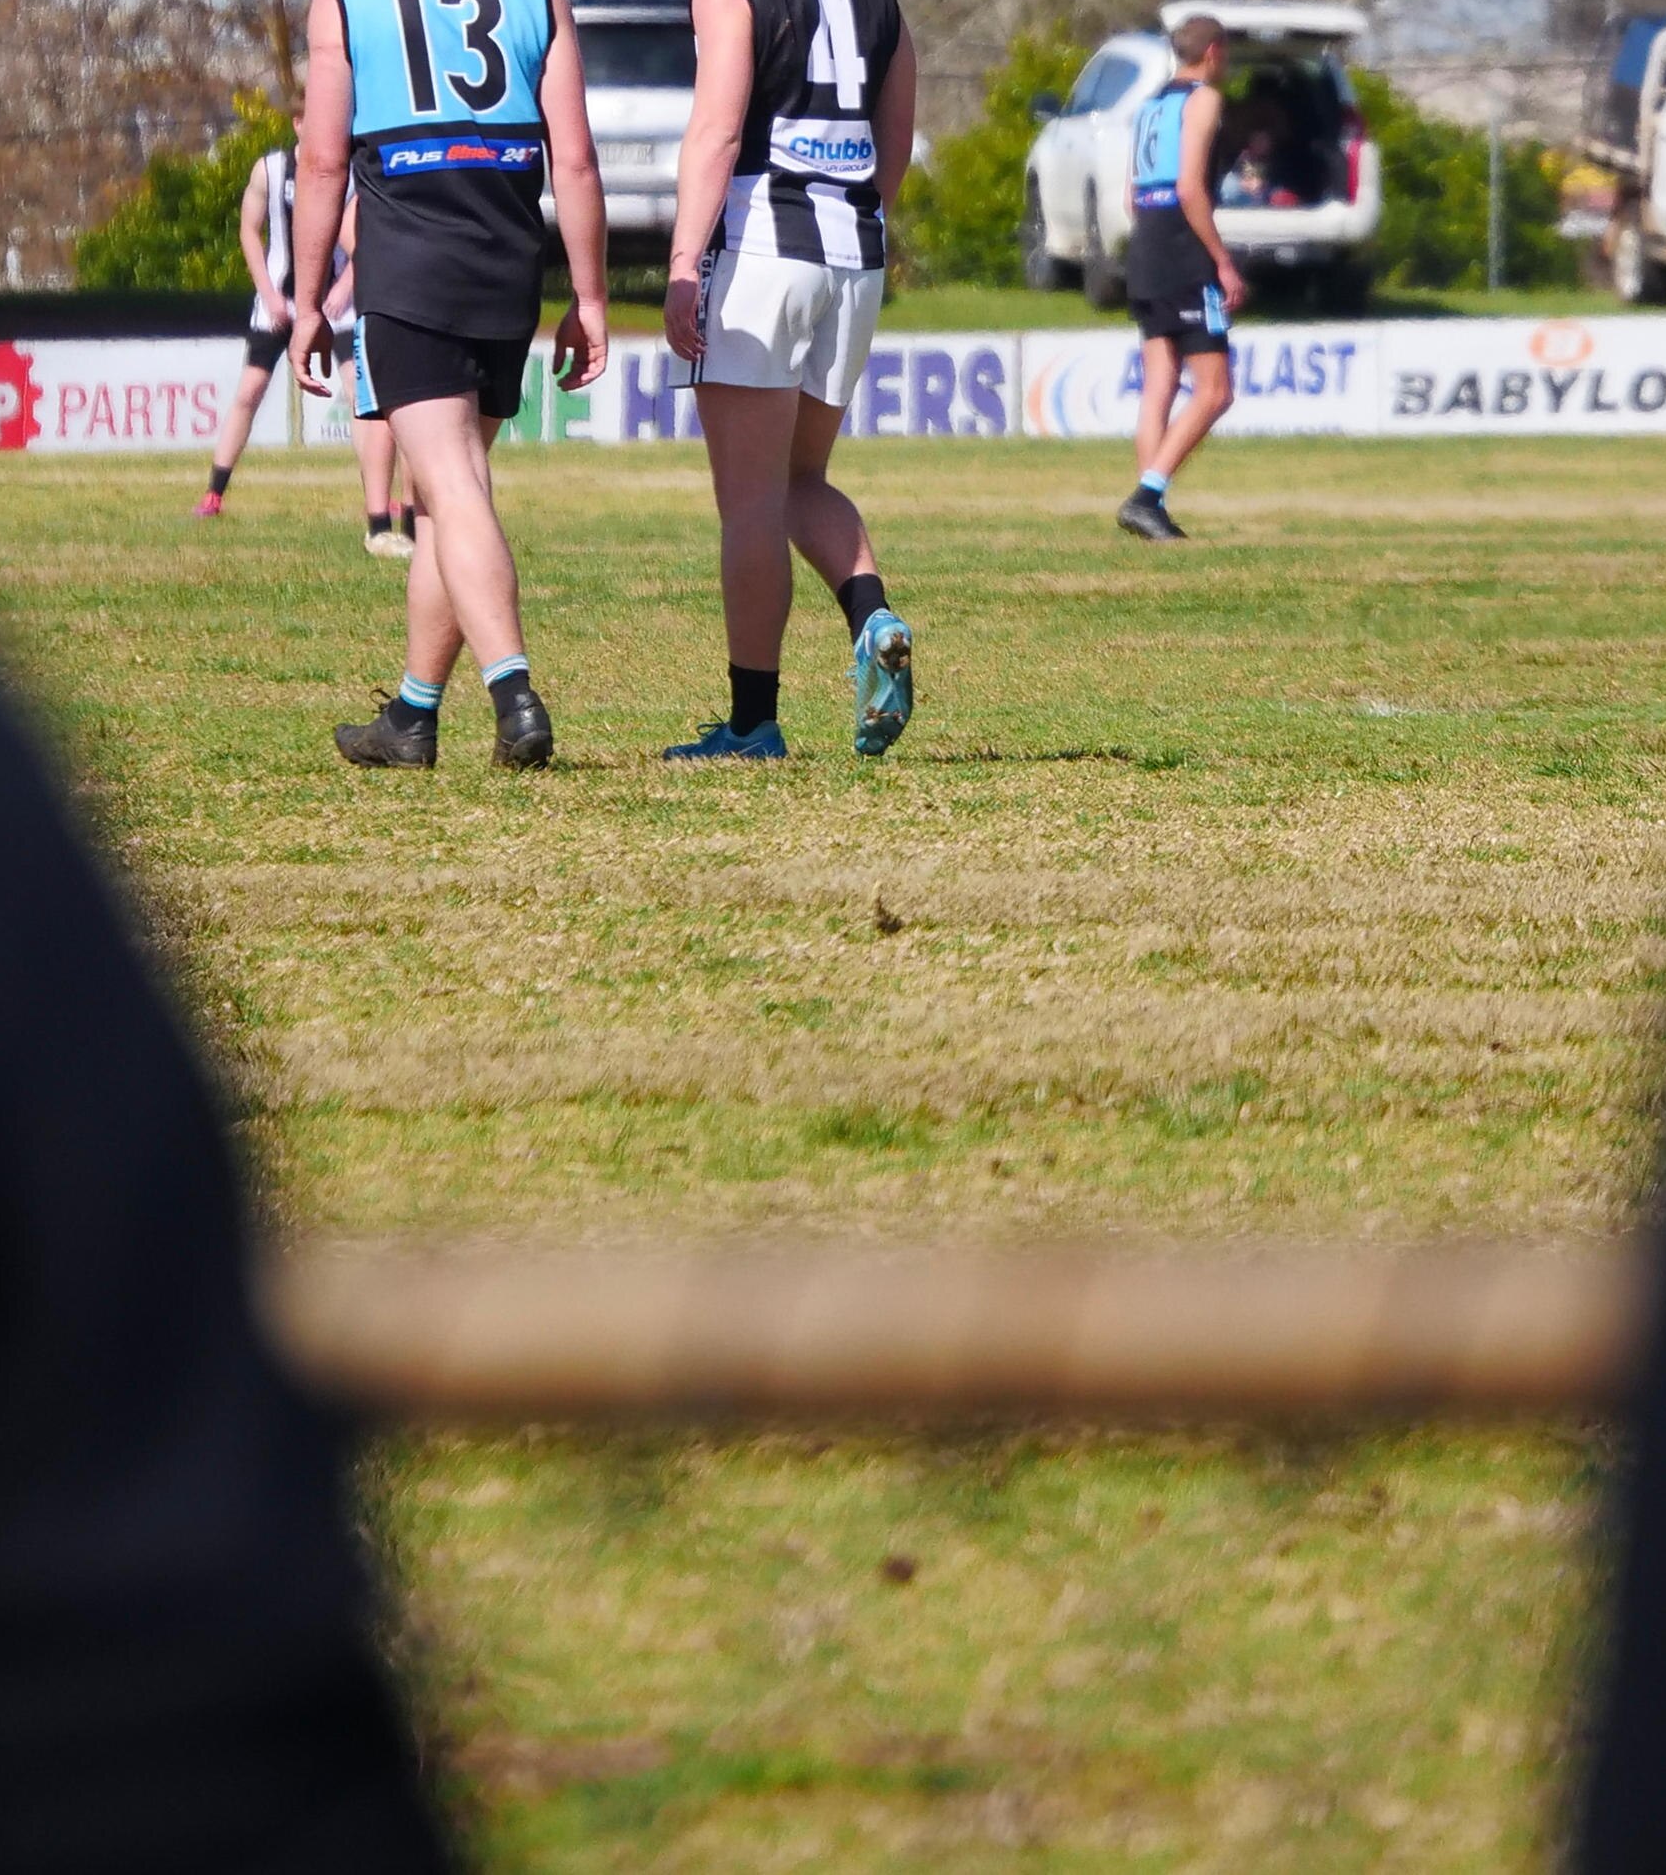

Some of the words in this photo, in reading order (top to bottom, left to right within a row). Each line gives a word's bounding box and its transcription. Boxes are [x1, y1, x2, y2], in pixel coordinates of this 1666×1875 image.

[389, 149, 443, 169] Plus
[789, 136, 872, 160] Chubb
[58, 382, 220, 438] PARTS
